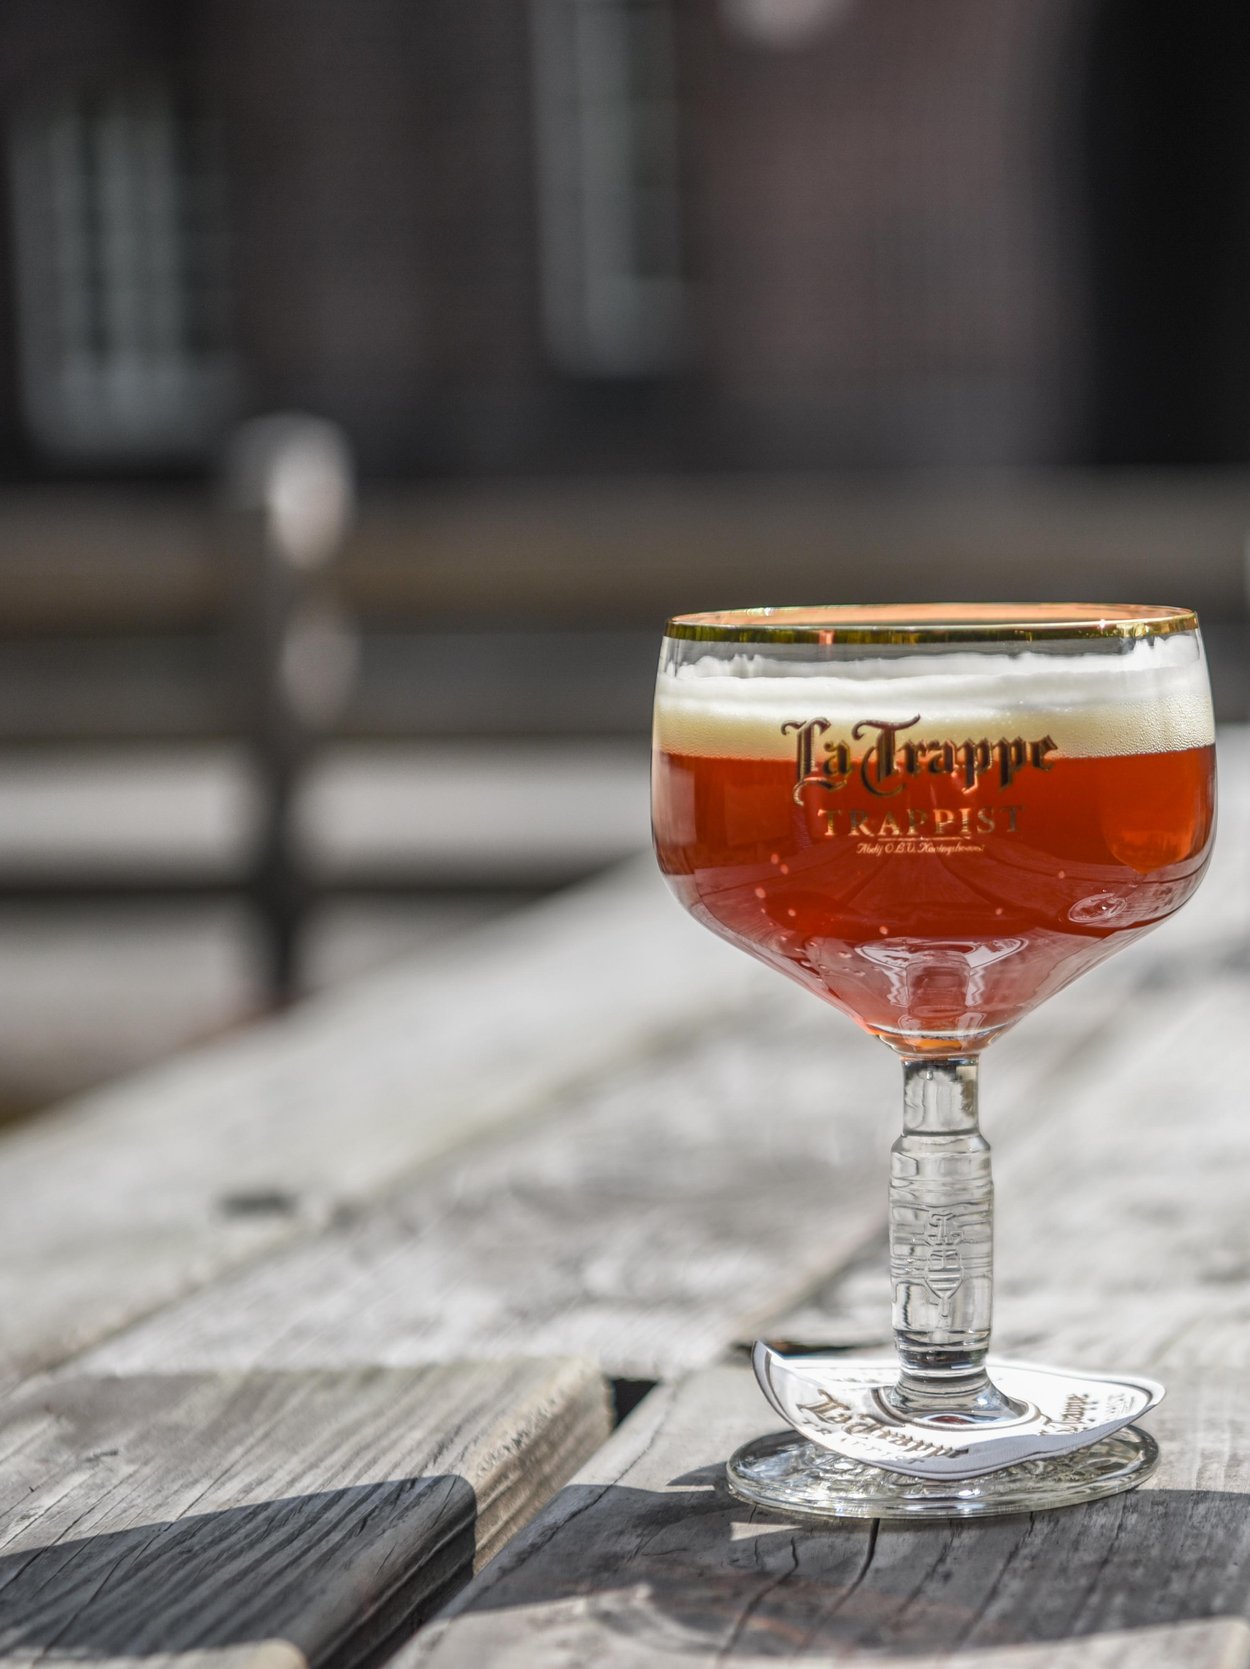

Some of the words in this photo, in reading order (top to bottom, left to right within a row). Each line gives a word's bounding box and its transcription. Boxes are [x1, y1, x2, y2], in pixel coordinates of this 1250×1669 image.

[780, 715, 854, 806] La
[850, 712, 1060, 797] Trappe
[817, 805, 1025, 837] TRAPPIST
